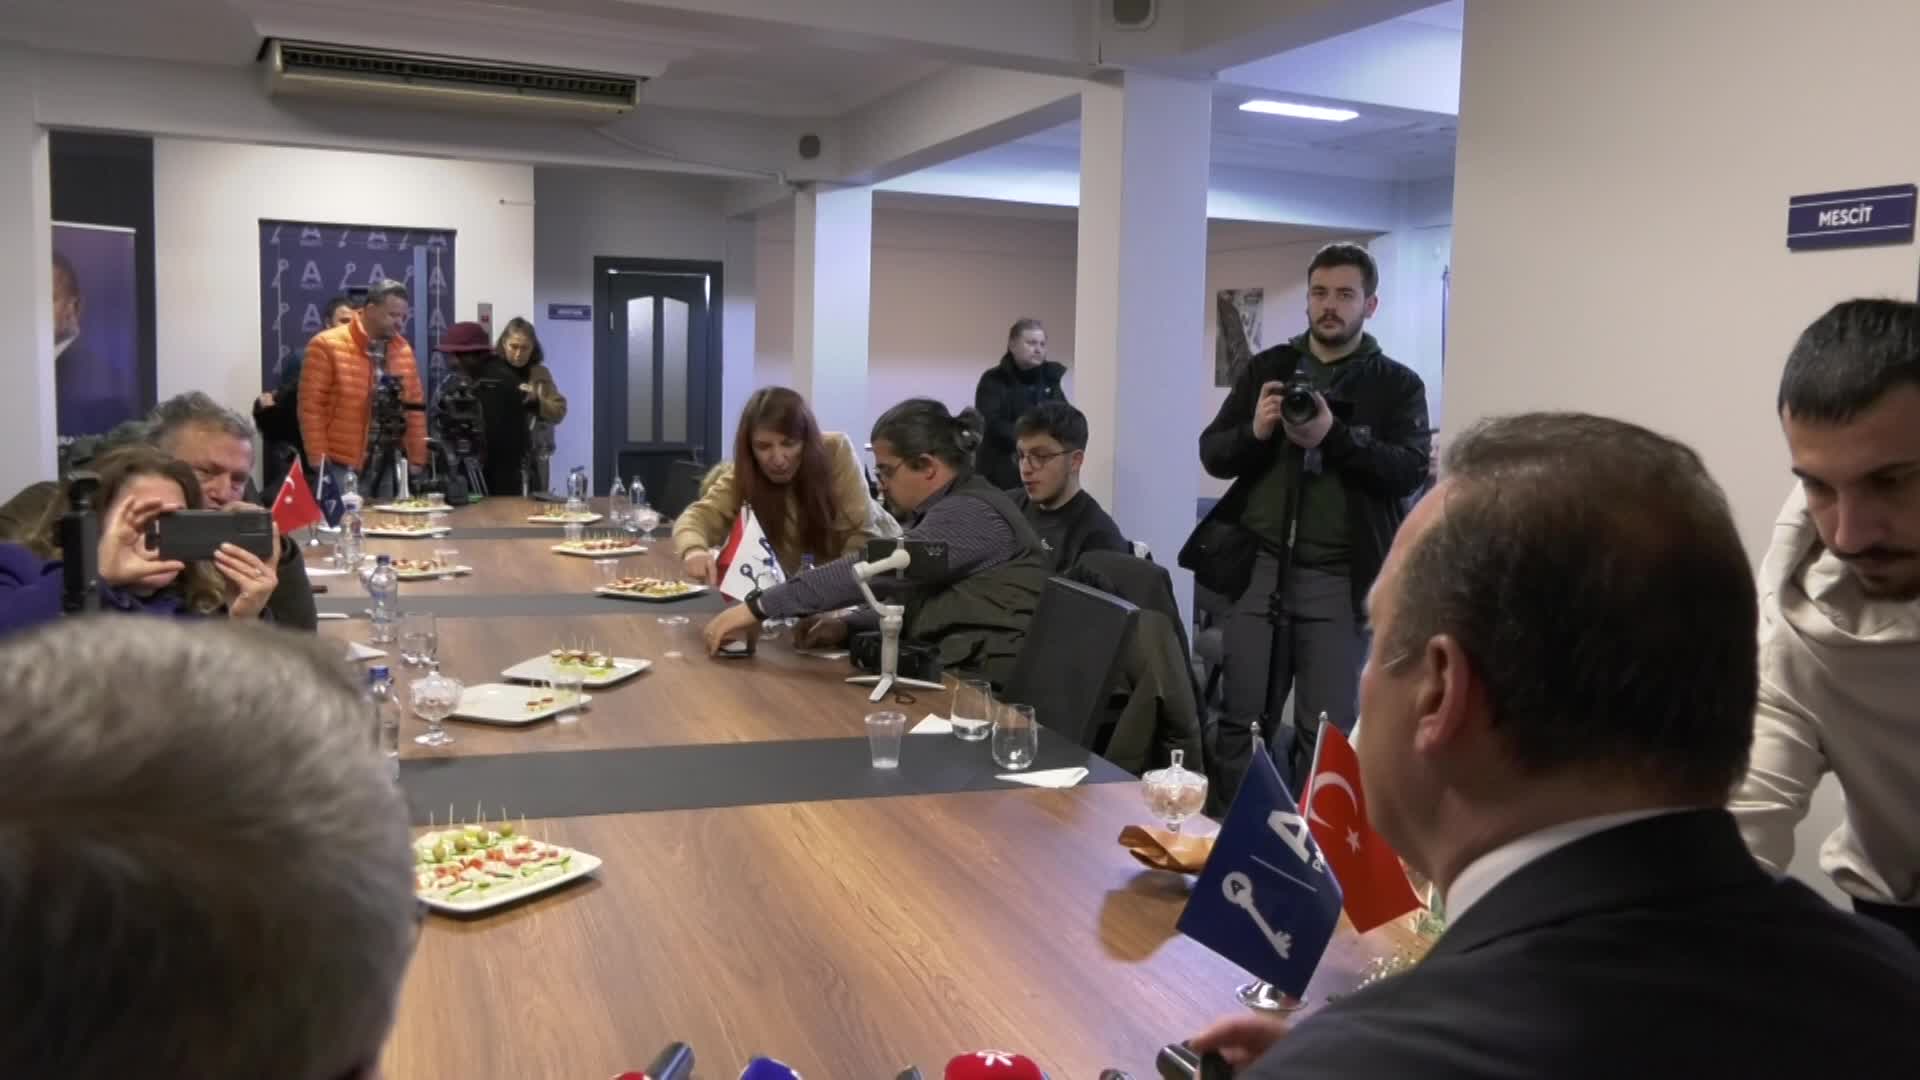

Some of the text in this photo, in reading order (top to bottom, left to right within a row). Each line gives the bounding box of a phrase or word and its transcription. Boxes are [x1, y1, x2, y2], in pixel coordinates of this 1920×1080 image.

[1818, 203, 1874, 227] MESCİT
[302, 260, 321, 285] A
[1267, 809, 1309, 864] A
